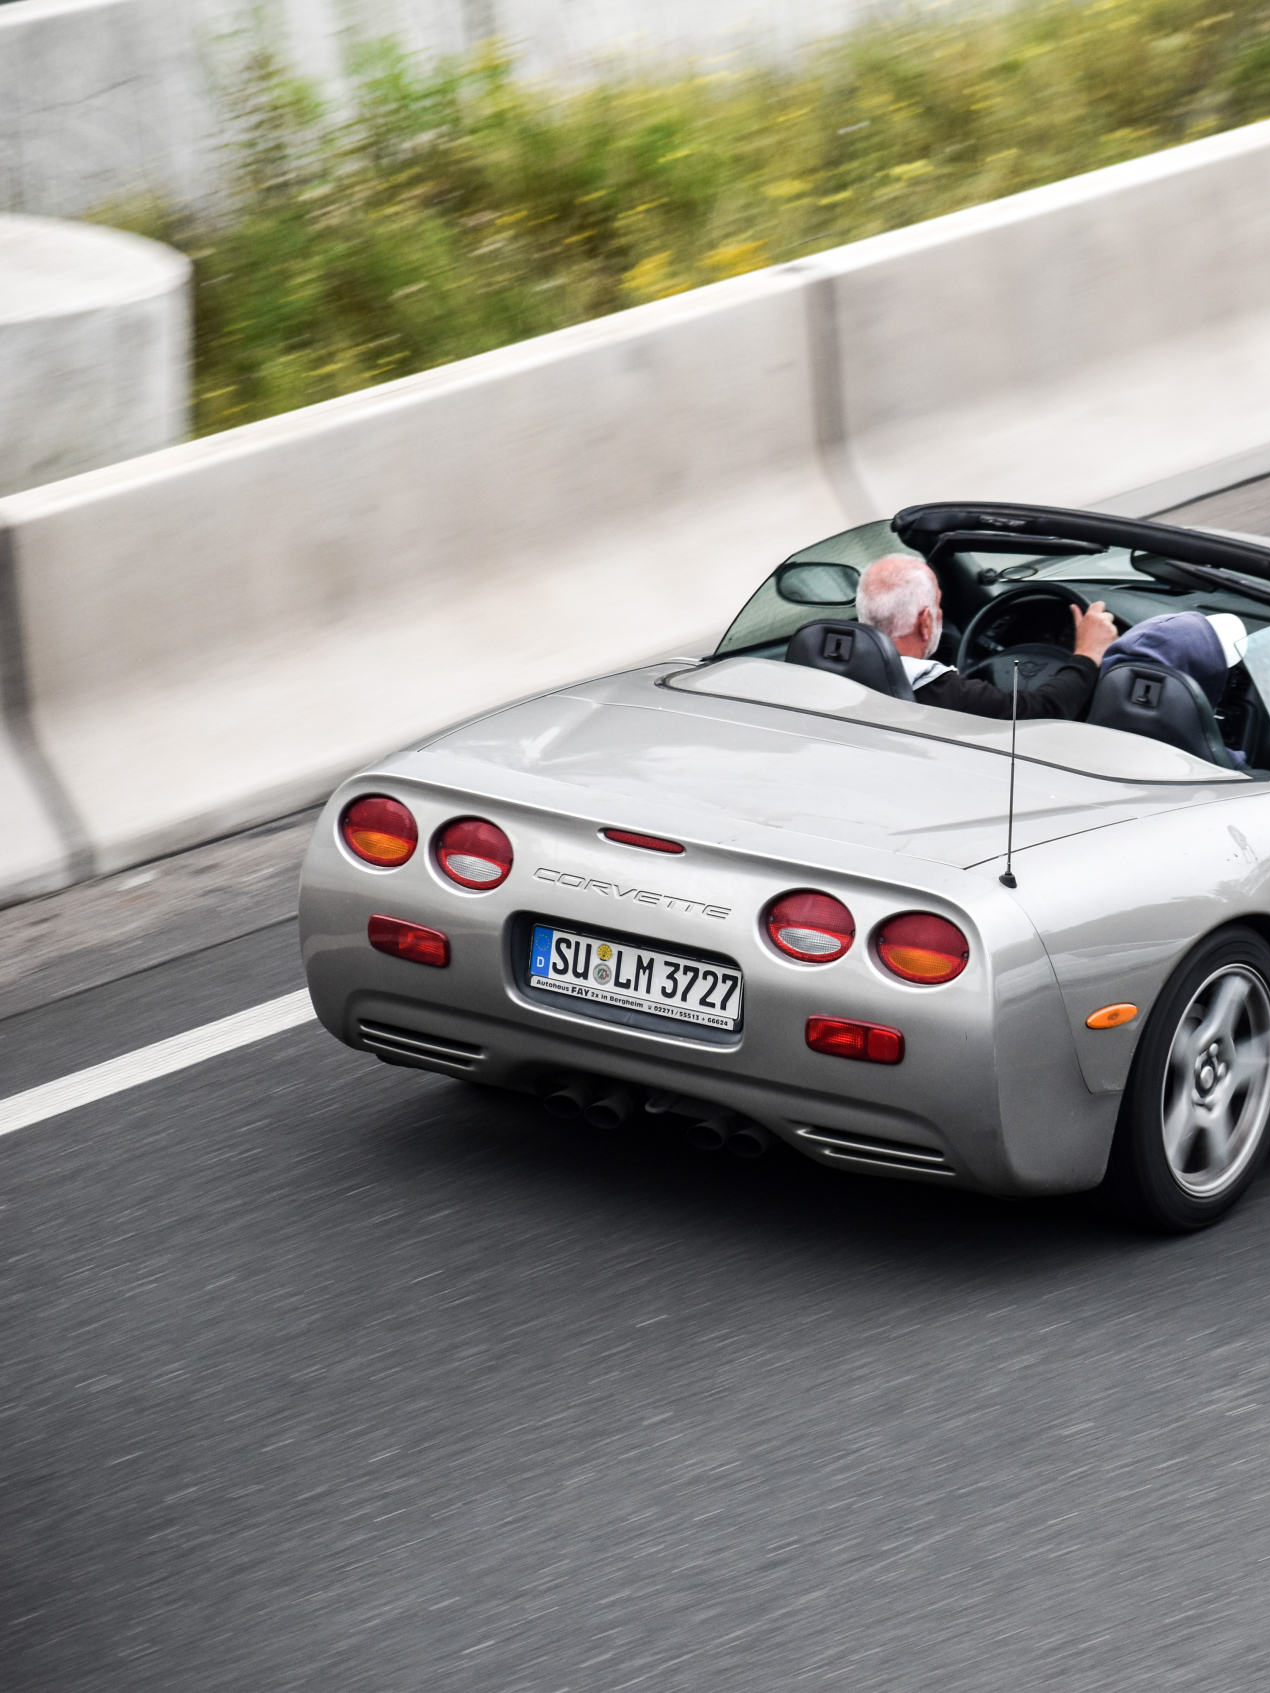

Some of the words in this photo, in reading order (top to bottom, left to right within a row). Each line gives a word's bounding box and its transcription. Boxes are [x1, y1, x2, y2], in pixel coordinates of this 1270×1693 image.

[533, 867, 731, 920] CORVETTE
[536, 956, 545, 968] D
[552, 937, 592, 980] SU
[614, 950, 655, 994] LM
[661, 960, 739, 1011] 3727
[536, 978, 570, 992] Autohaus
[571, 986, 590, 998] FAY
[601, 993, 608, 1001] in
[609, 995, 644, 1009] Bergheim
